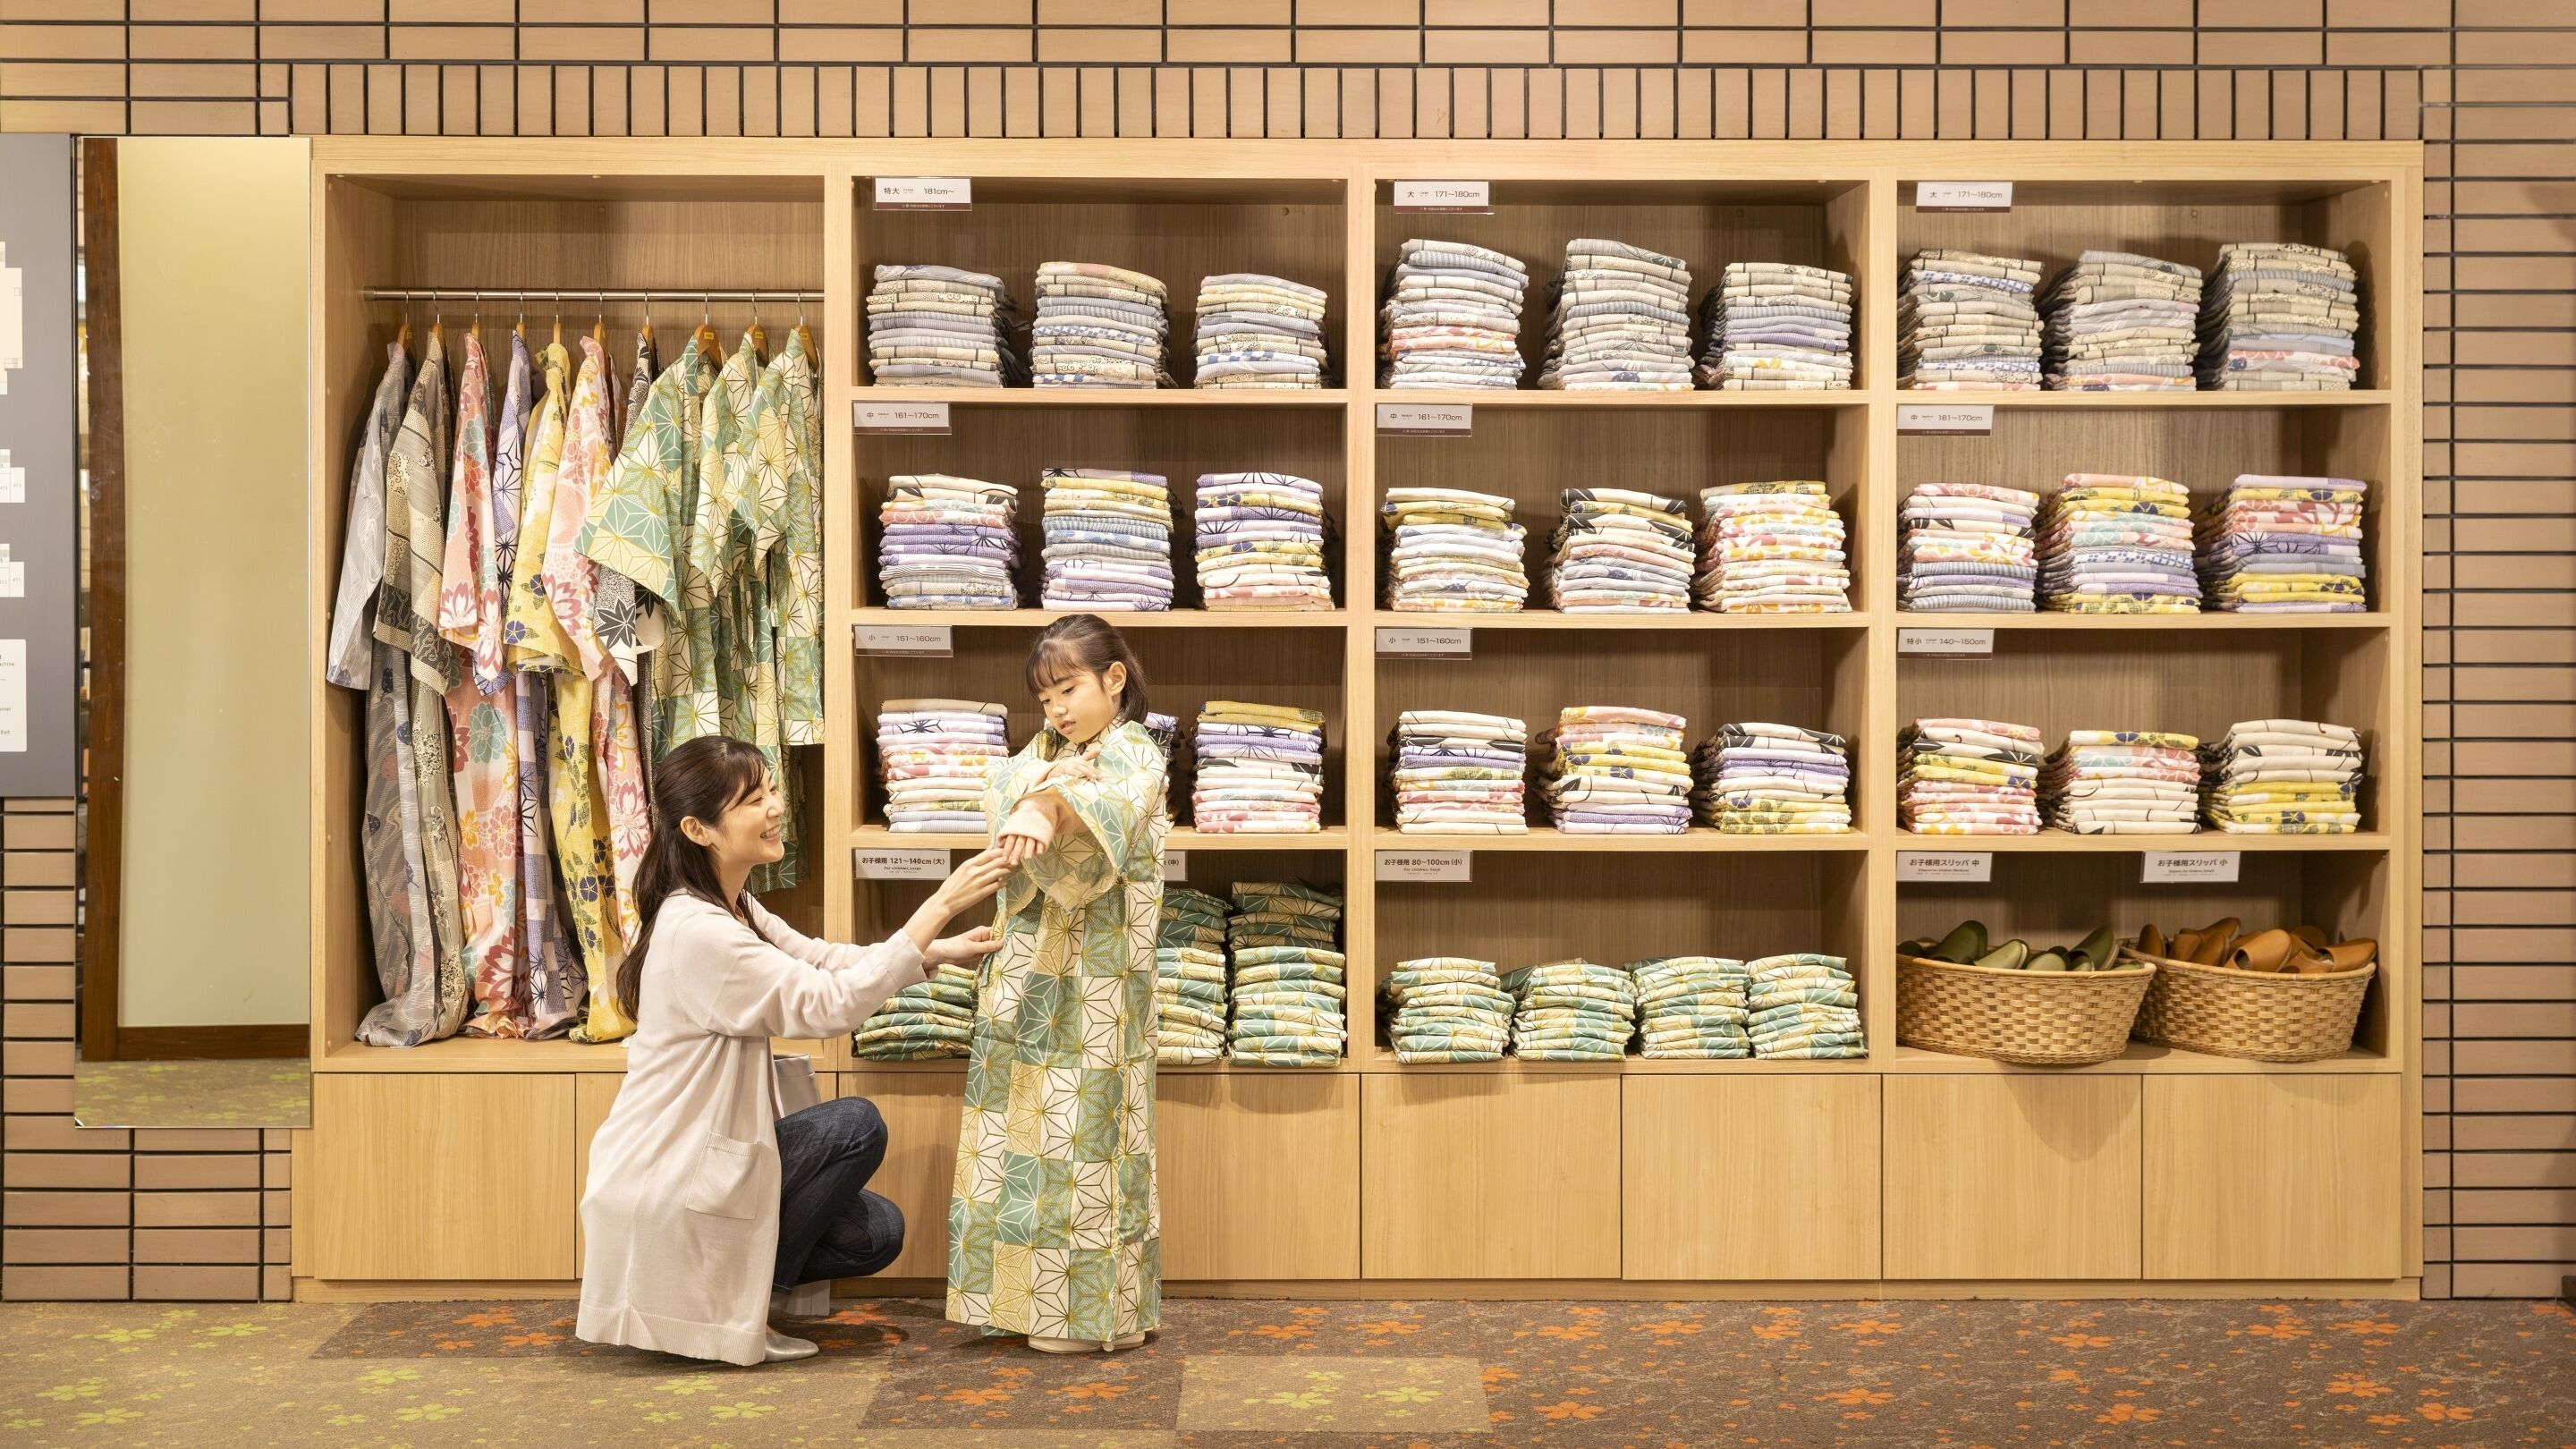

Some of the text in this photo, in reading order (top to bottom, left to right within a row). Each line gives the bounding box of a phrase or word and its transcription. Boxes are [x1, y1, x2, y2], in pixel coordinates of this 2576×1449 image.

[884, 187, 900, 195] 特大
[1909, 859, 1970, 867] お子様用スリッパ
[2157, 859, 2227, 867] お子様用スリッパ 小
